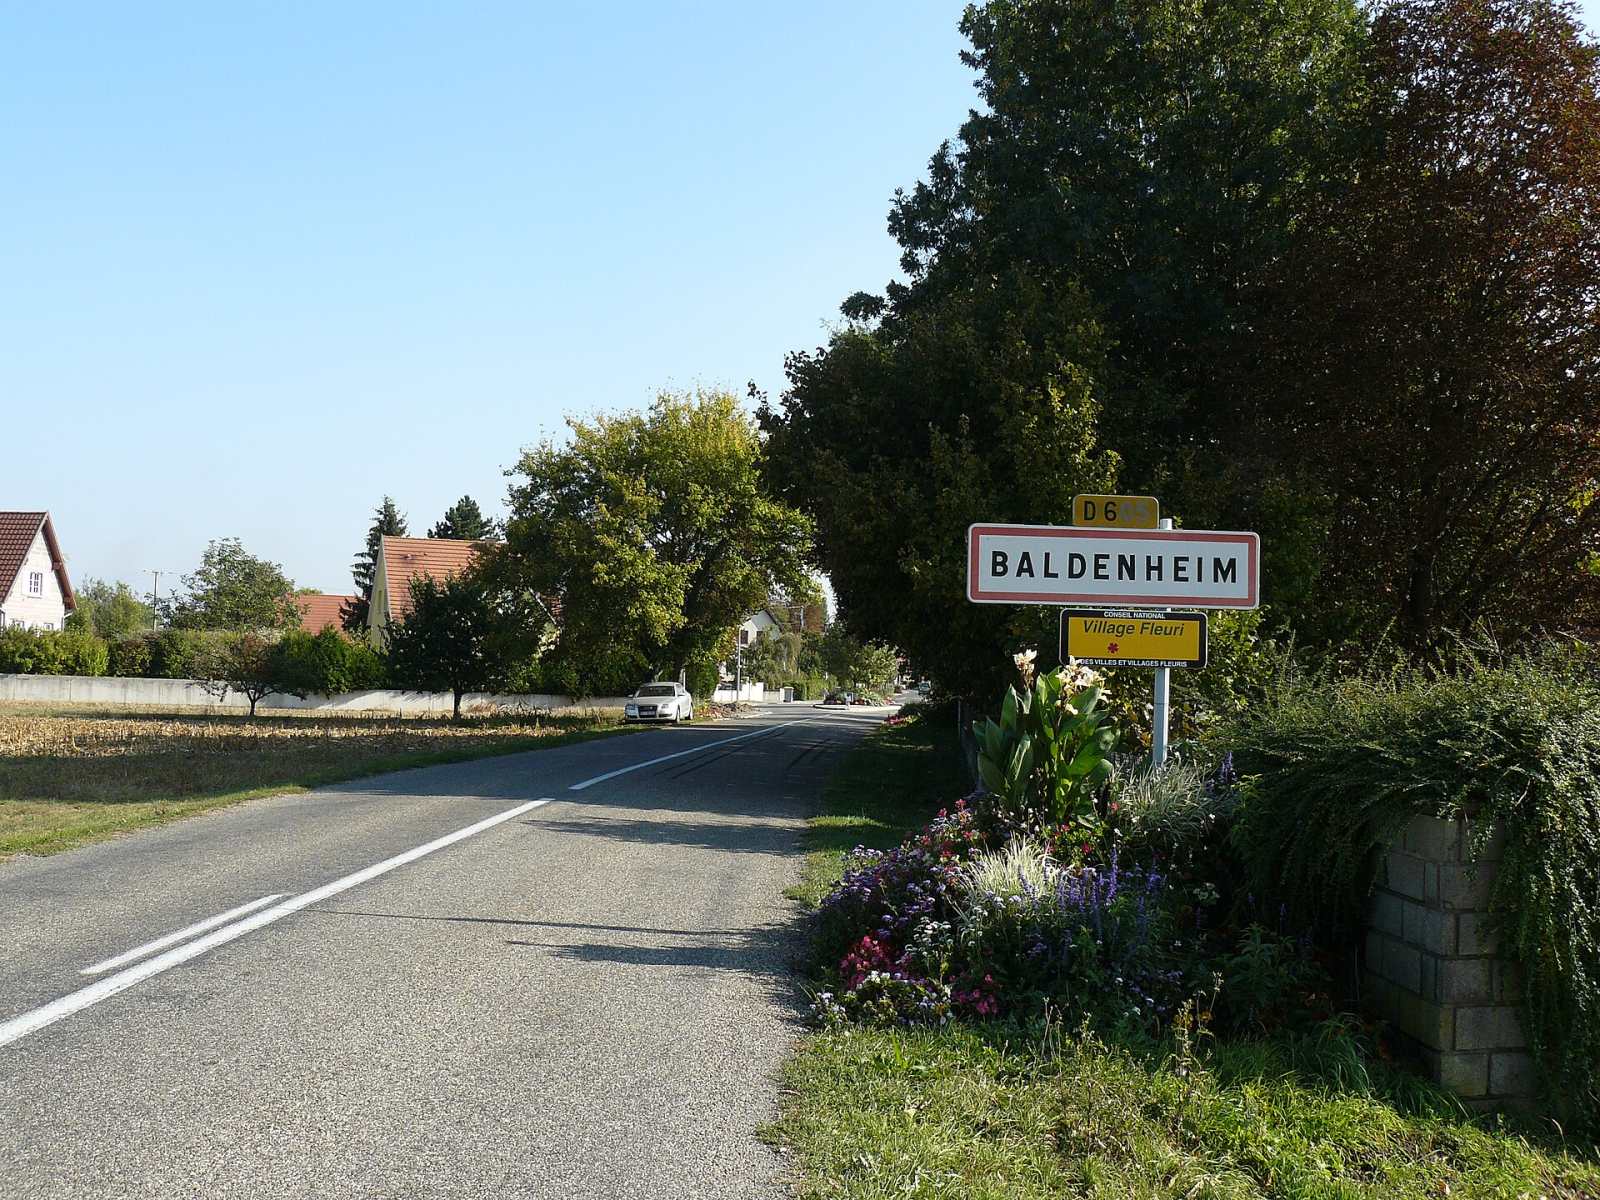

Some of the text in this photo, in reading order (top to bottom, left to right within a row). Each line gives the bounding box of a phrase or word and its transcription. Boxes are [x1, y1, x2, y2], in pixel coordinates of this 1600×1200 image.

[1084, 501, 1096, 520] D
[991, 551, 1237, 583] BALDENHEIM
[1084, 620, 1184, 637] Village Fleuri
